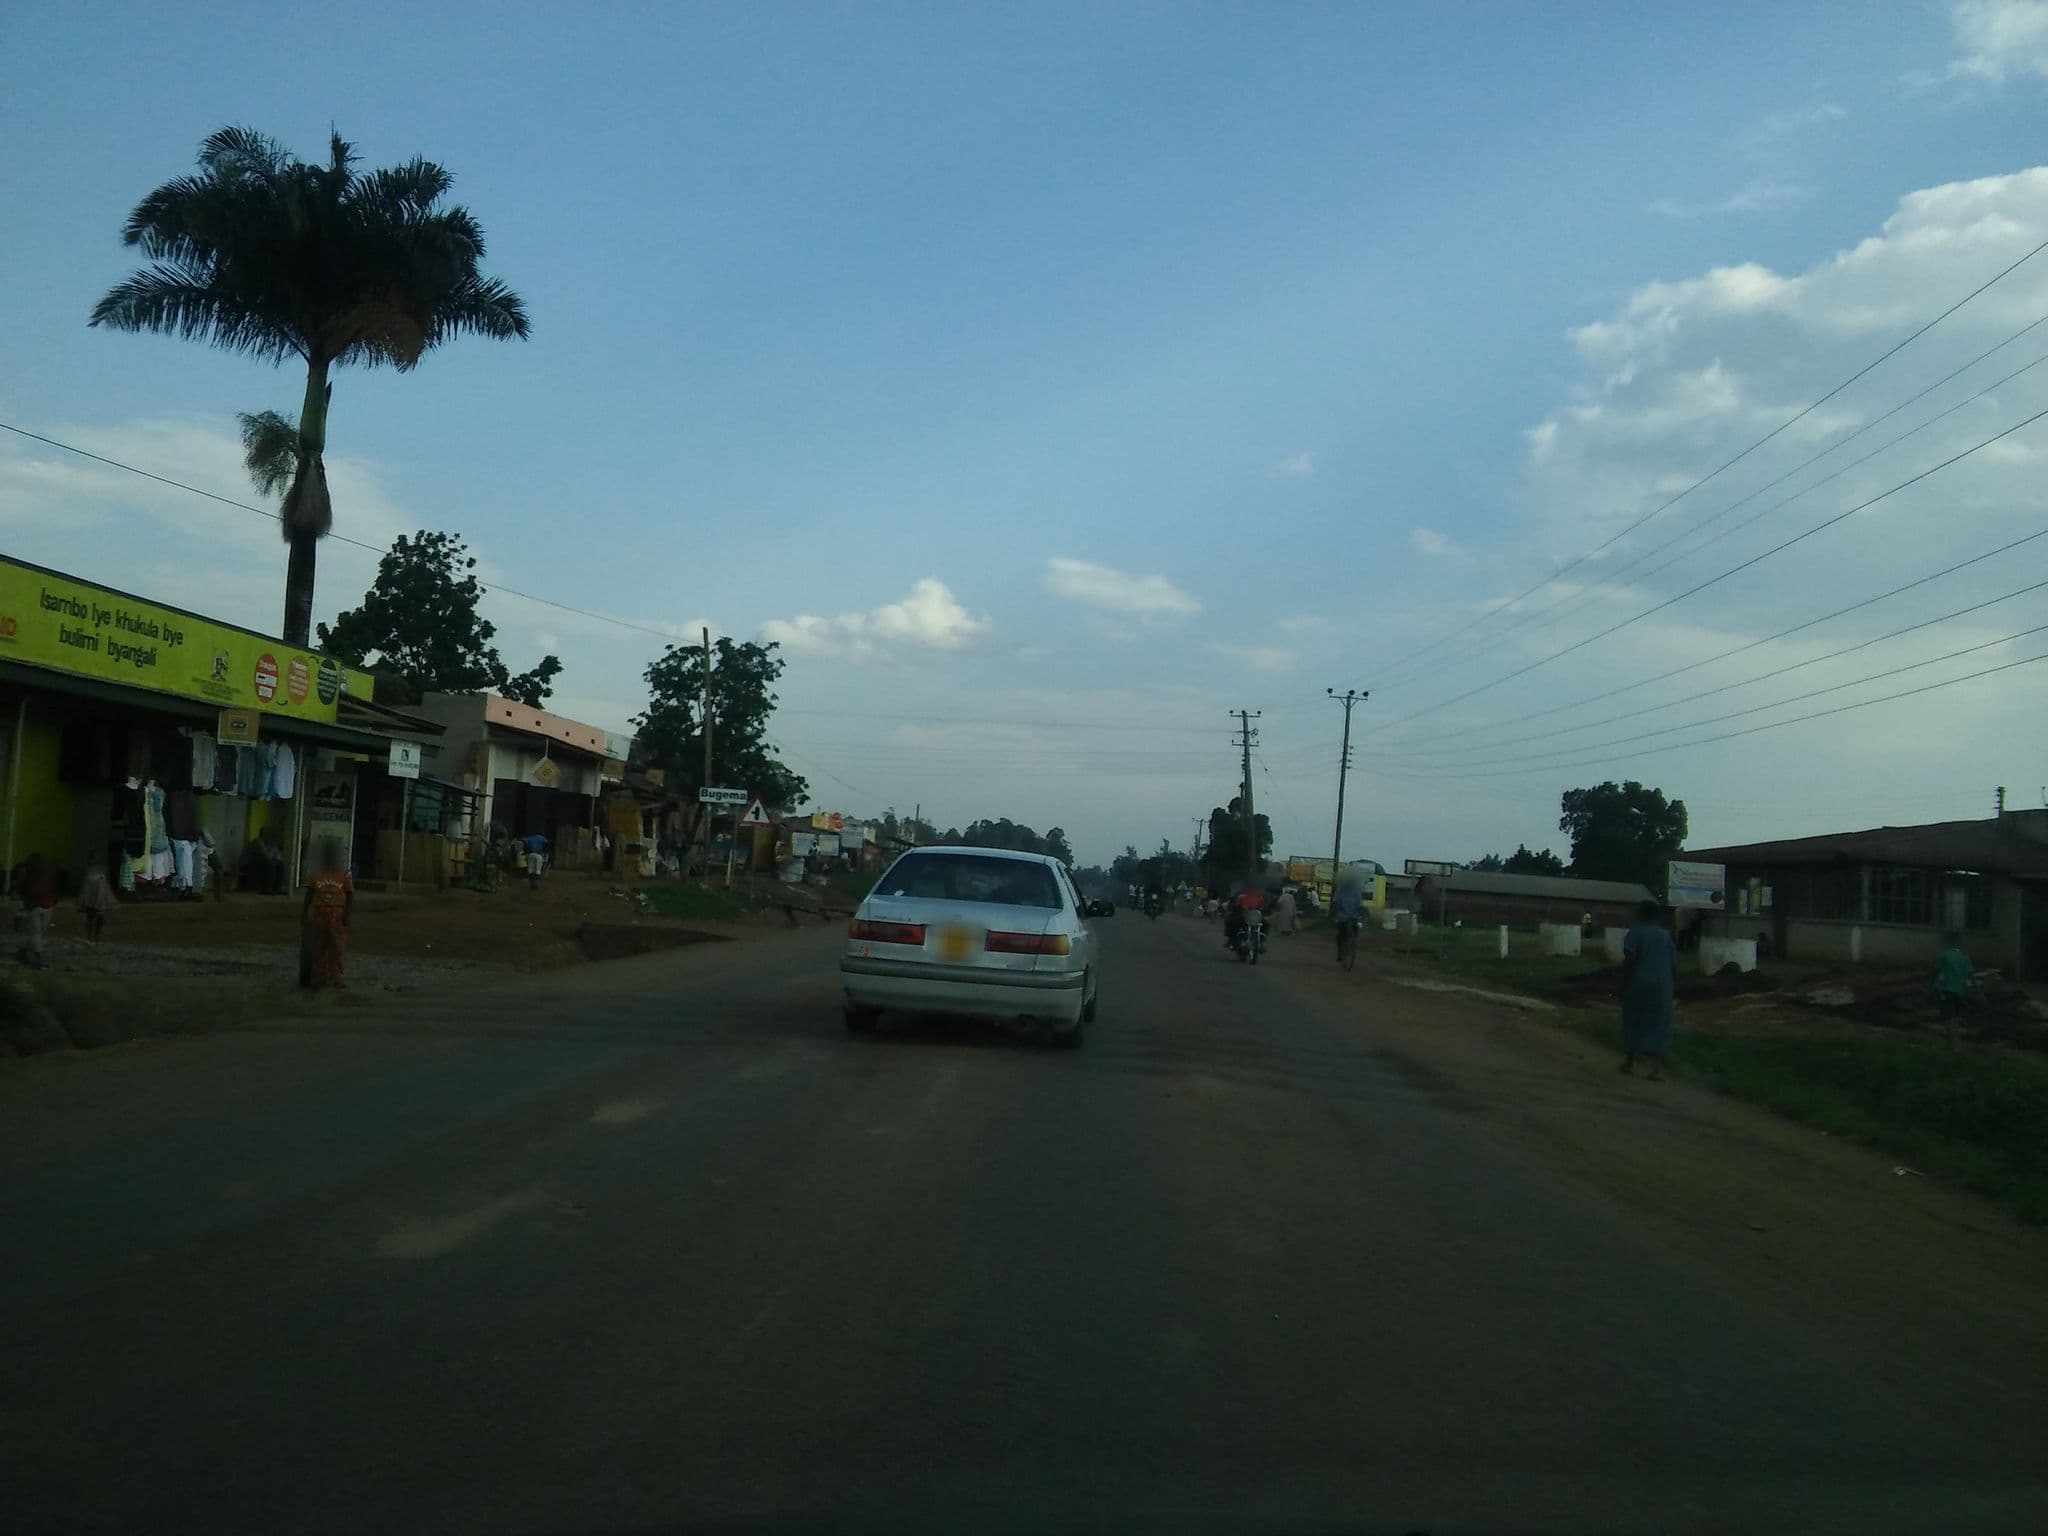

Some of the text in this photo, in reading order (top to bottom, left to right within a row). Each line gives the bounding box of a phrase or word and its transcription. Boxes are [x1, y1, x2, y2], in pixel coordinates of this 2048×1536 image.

[40, 587, 87, 619] Isambo
[115, 609, 159, 639] khukula
[163, 622, 184, 648] bye
[59, 623, 157, 668] bulimi byangali
[701, 788, 746, 801] Bugema
